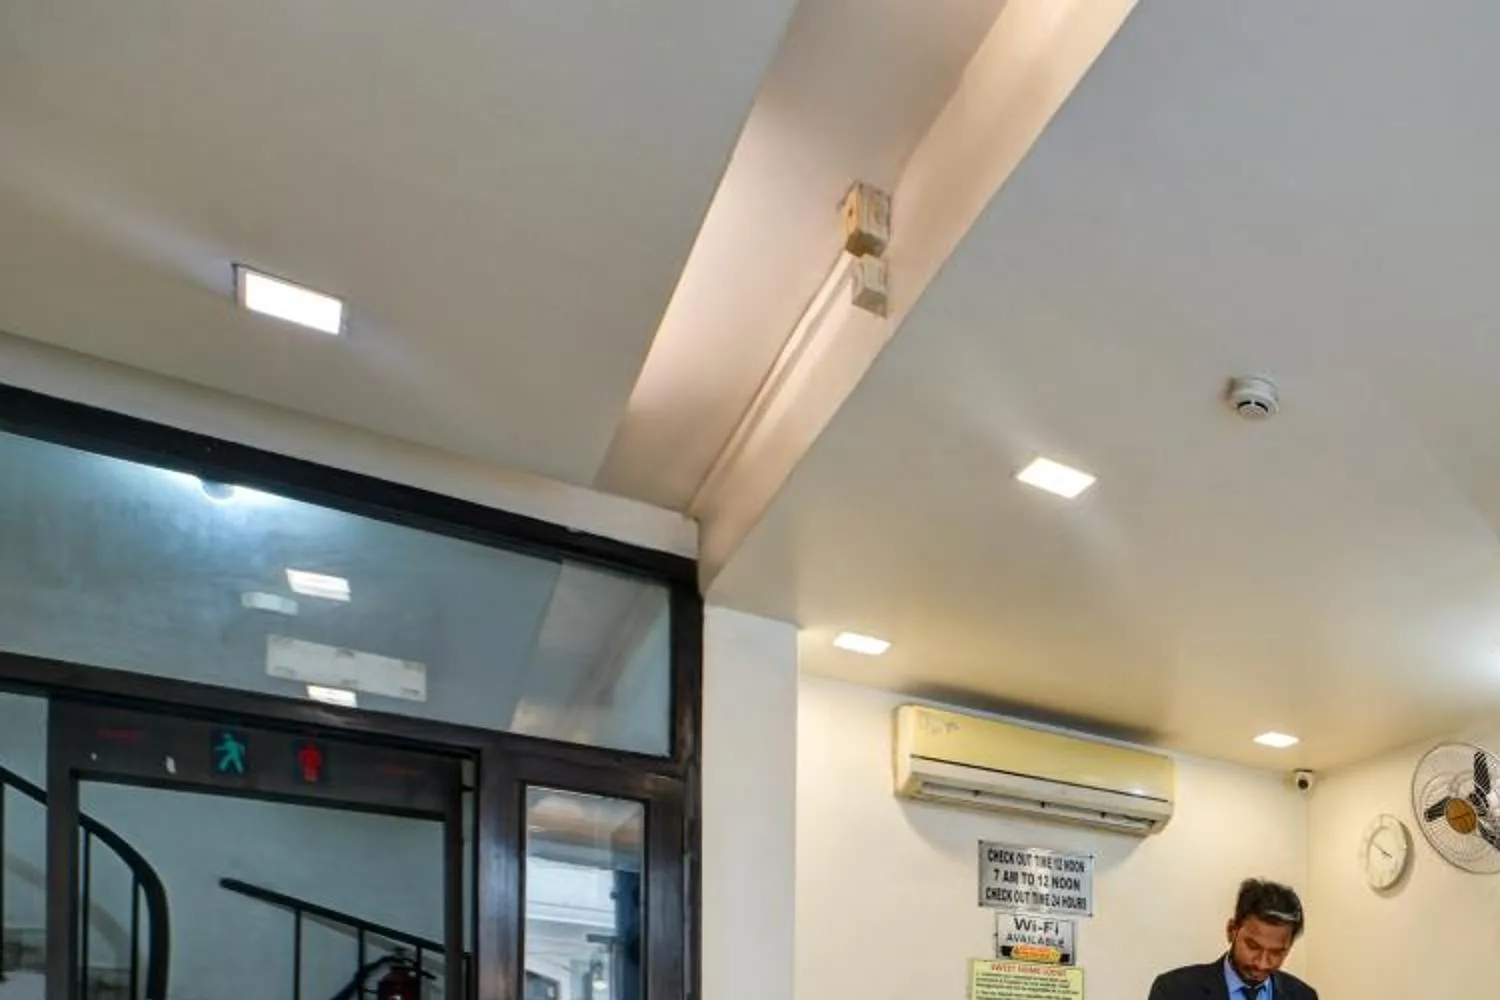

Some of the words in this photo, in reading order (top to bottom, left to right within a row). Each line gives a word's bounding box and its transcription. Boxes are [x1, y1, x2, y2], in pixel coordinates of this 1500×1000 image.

[987, 848, 1014, 865] CHECK
[993, 868, 999, 880] 7
[1022, 871, 1035, 886] TO
[1038, 873, 1049, 887] 12
[1052, 876, 1081, 891] NOON
[985, 886, 1012, 902] CHECK
[1014, 917, 1059, 935] Wi-Fi
